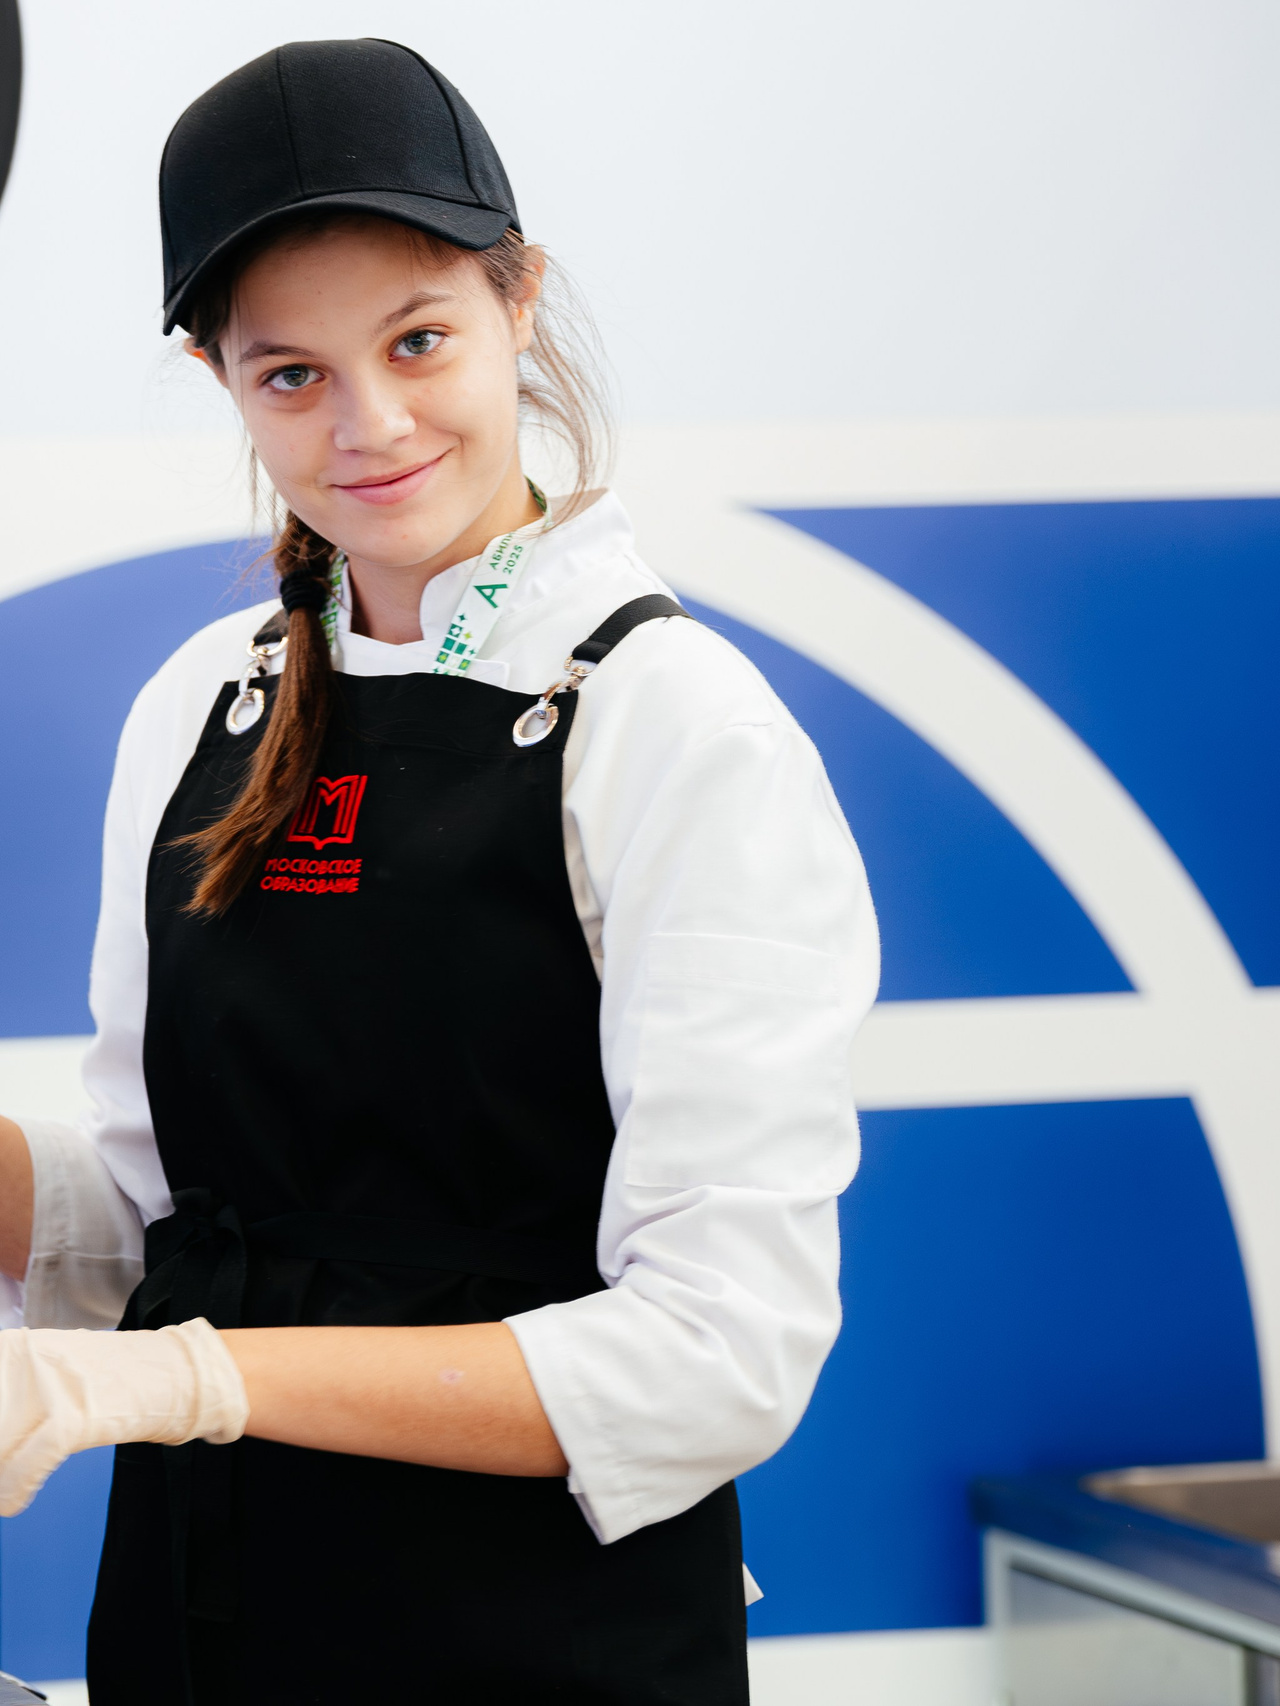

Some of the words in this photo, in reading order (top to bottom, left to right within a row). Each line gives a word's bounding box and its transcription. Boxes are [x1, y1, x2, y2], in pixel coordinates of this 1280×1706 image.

[502, 545, 524, 575] 2025
[473, 583, 508, 609] А
[264, 858, 363, 875] МОСКОВСКОЕ
[260, 876, 360, 895] ОБРАЗОВАНИЕ
